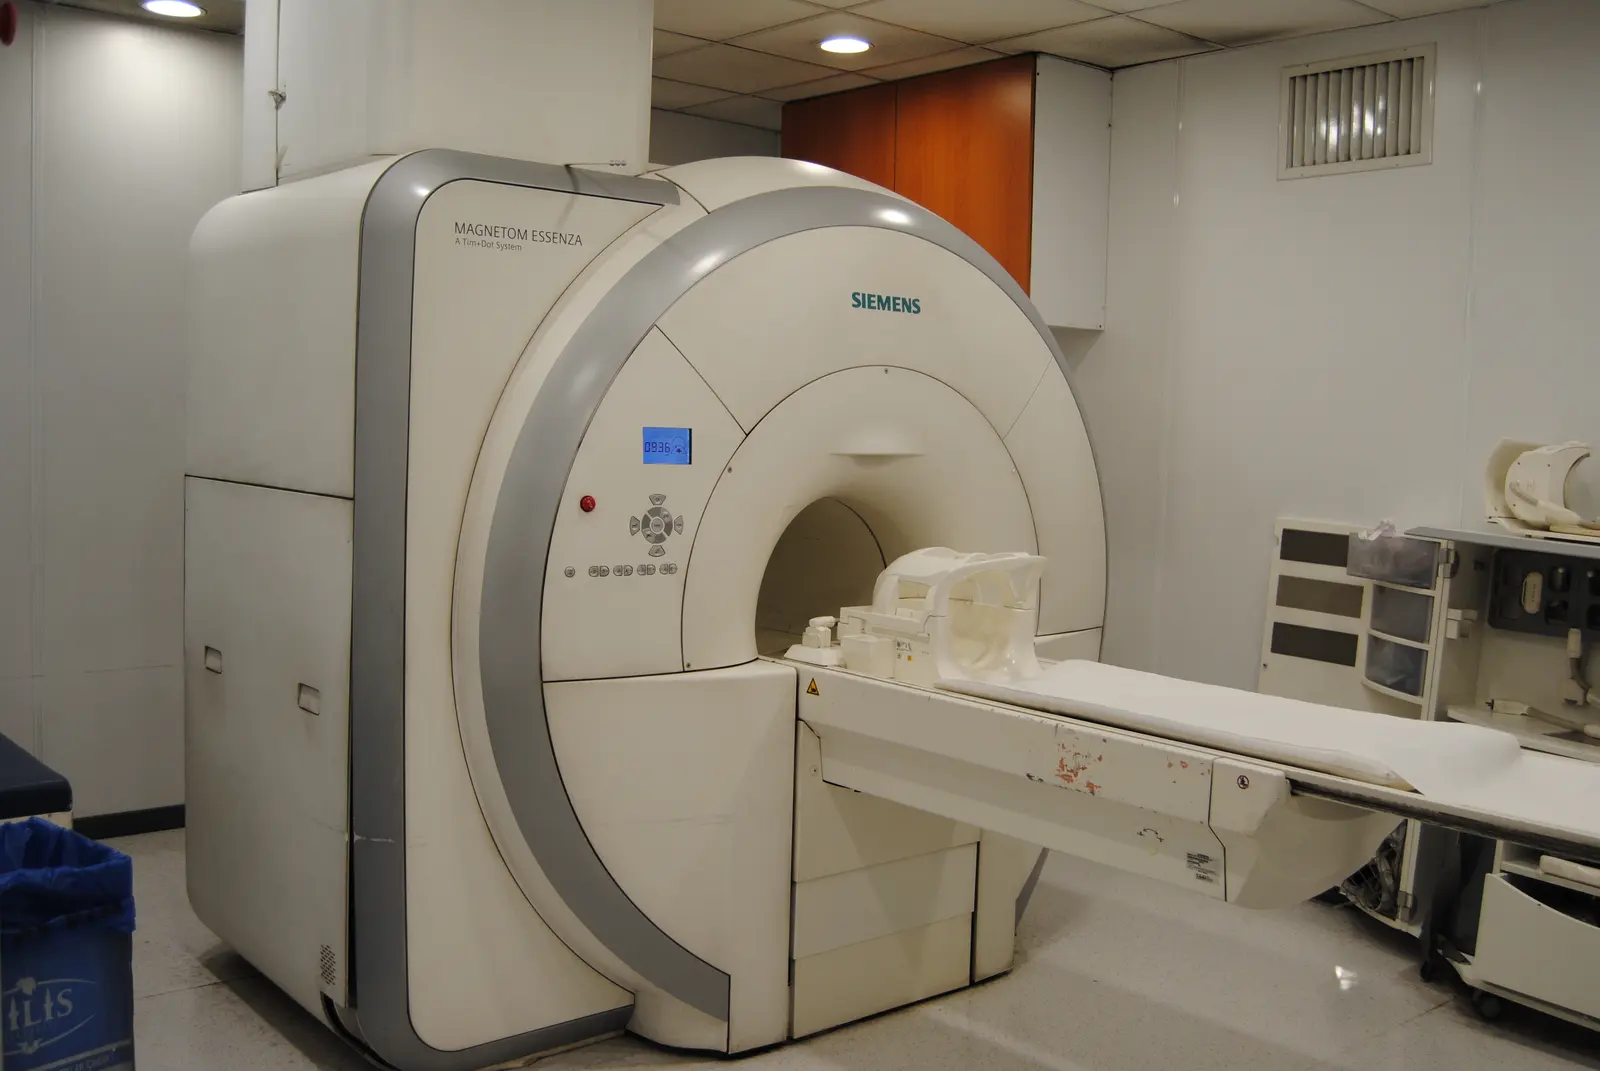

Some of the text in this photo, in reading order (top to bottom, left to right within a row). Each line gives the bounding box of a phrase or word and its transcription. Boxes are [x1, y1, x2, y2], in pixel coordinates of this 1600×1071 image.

[454, 222, 583, 247] MAGNETOM ESSENZA
[454, 237, 522, 252] A Tim+Dot System
[851, 291, 921, 315] SIEMENS
